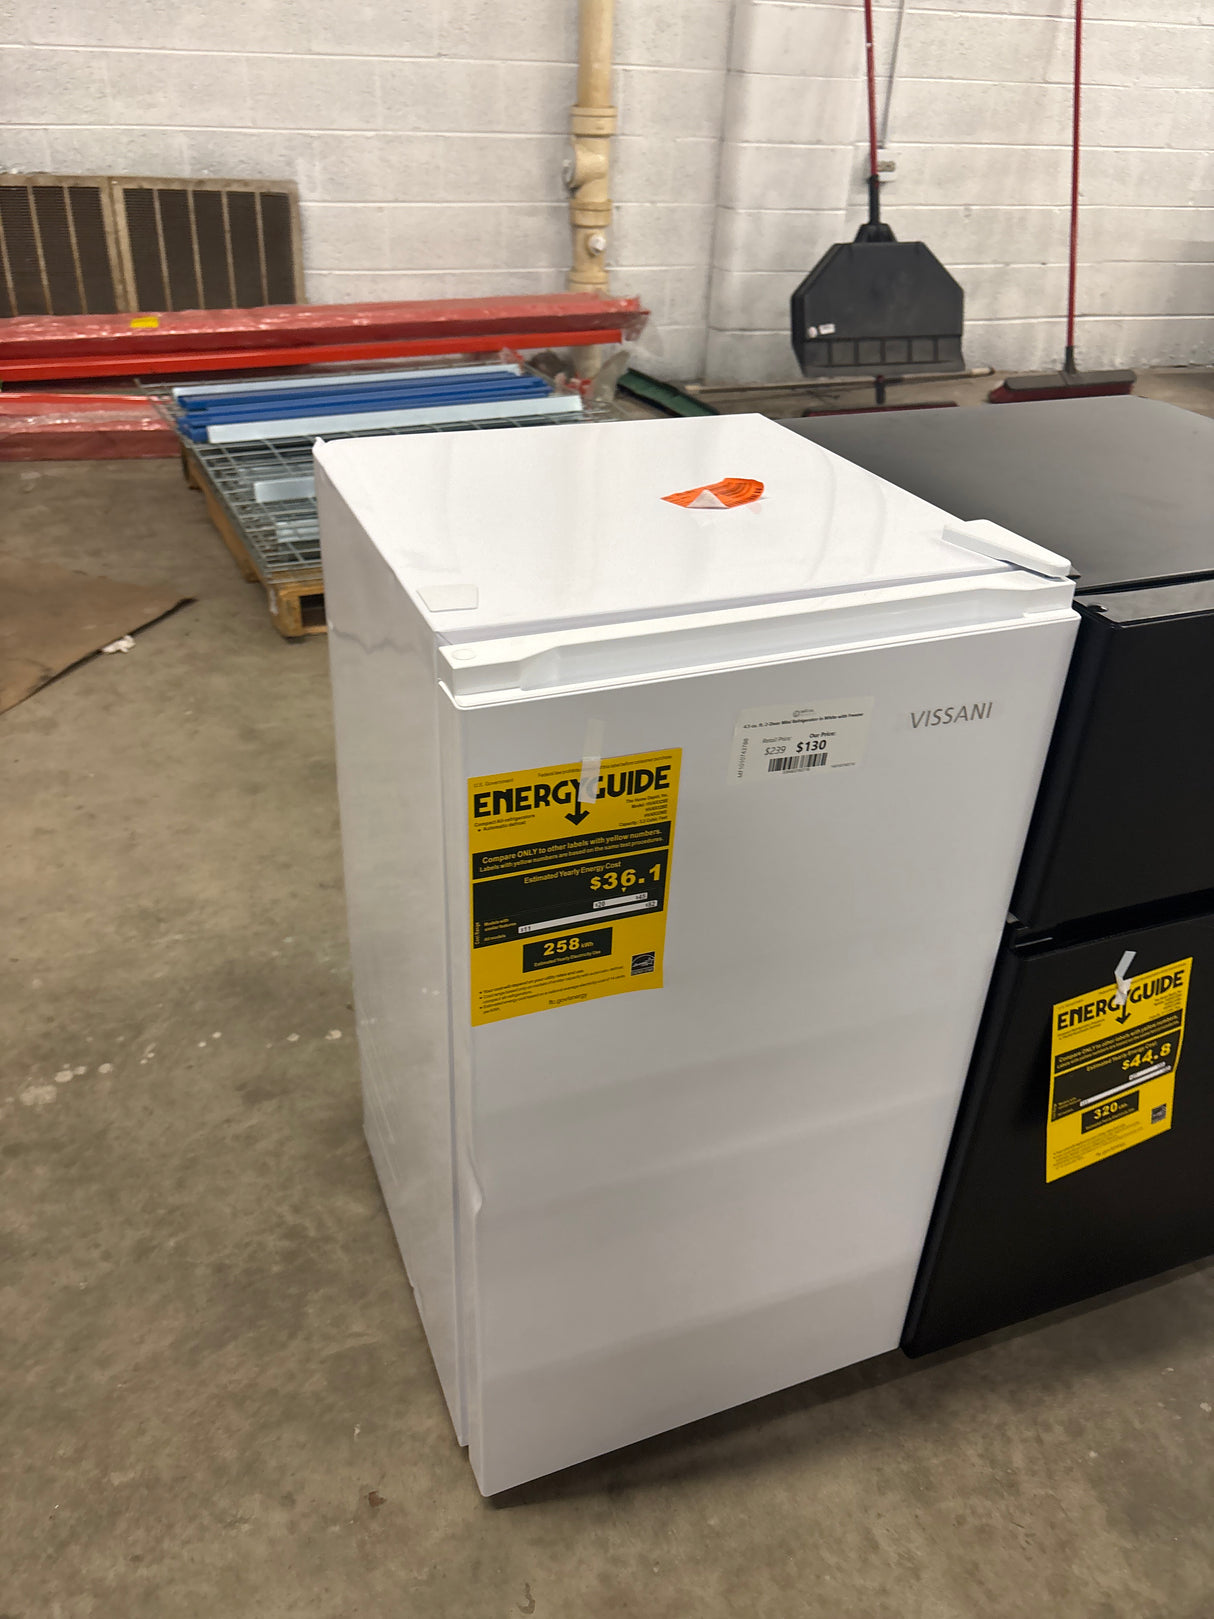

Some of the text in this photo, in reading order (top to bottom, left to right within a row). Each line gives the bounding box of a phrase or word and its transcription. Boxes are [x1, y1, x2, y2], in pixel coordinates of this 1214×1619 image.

[910, 702, 993, 728] VISSANI
[764, 746, 786, 756] $239
[796, 739, 827, 753] $130
[482, 828, 662, 865] Compare ONLY to other labels with yellow numbers.
[479, 864, 499, 872] Labels
[523, 861, 621, 884] Estimated Yearly Energy Cost
[590, 863, 661, 891] $36.1
[543, 938, 580, 956] 258
[1122, 1043, 1171, 1070] $44.8
[1093, 1102, 1118, 1120] 320
